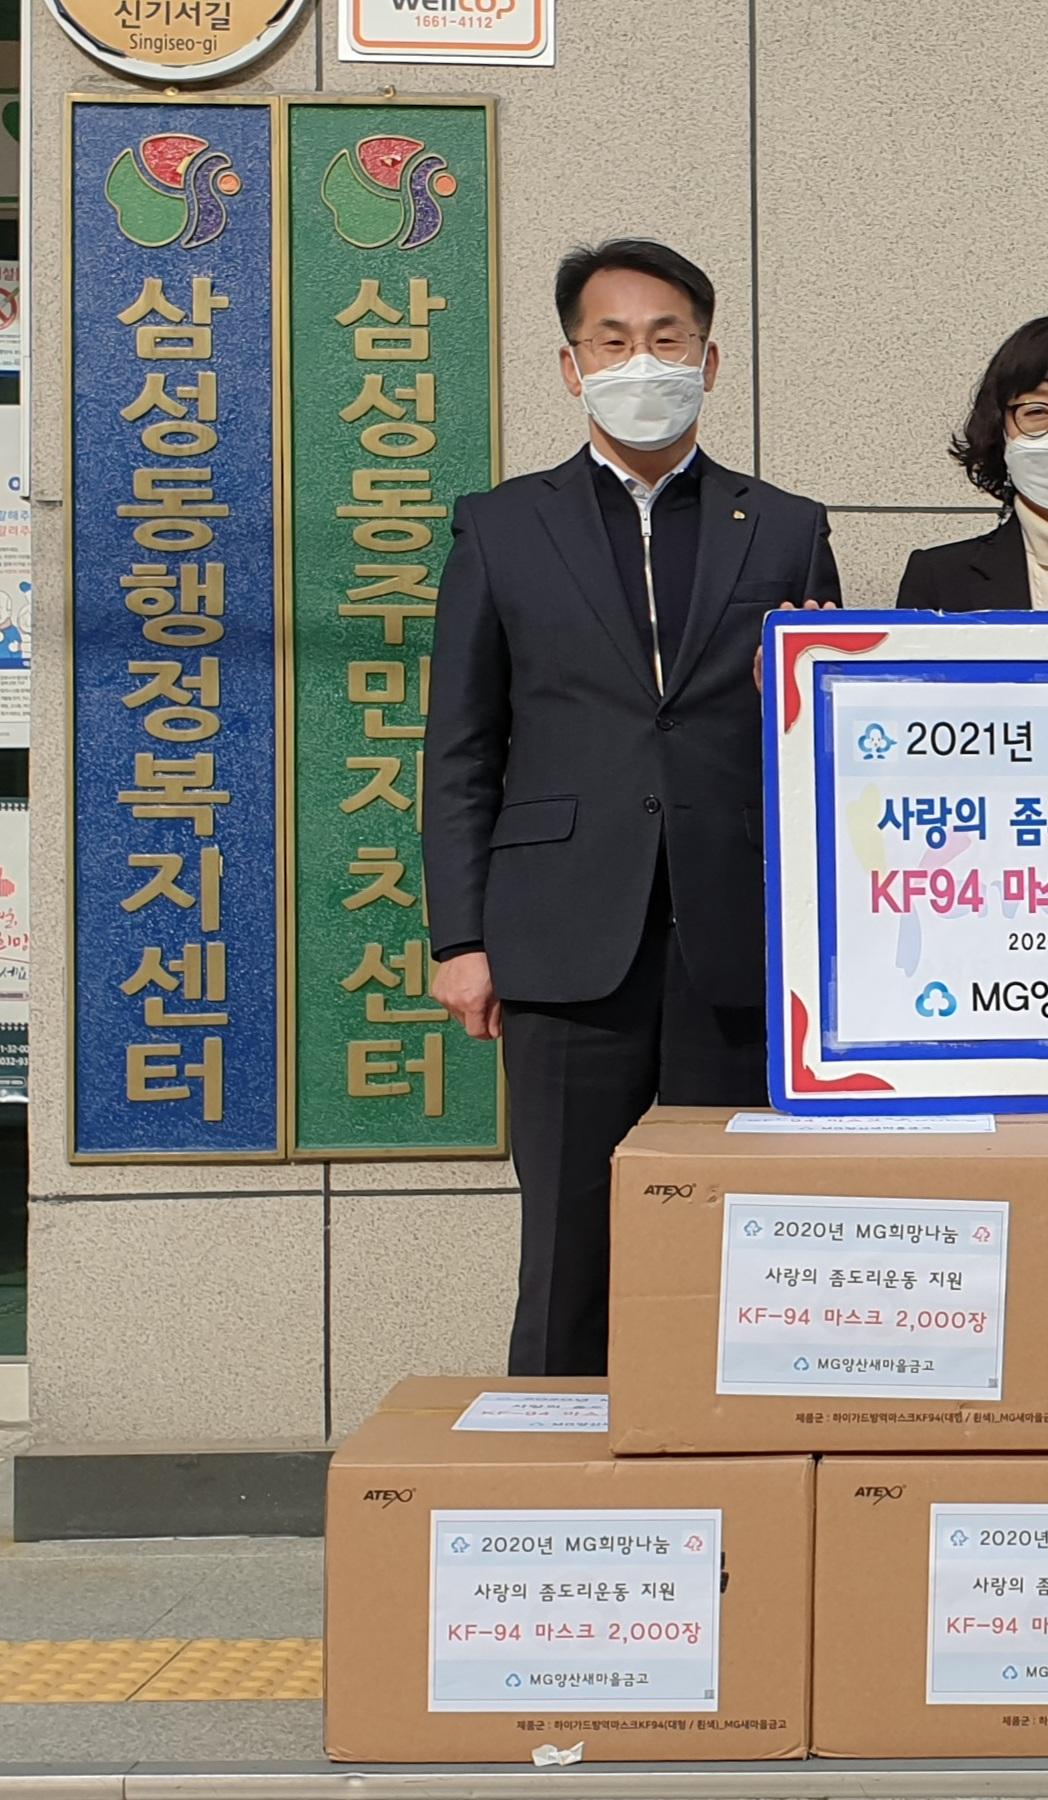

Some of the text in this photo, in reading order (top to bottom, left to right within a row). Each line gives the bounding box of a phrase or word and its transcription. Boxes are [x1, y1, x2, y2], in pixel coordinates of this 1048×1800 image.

[114, 0, 230, 31] 신기서길
[415, 15, 492, 28] 1661-4112
[130, 33, 216, 55] Singiseo-gi
[116, 277, 230, 1121] 삼성동행정복지센터
[907, 721, 1032, 762] 2021년
[878, 797, 986, 849] 사랑의
[872, 869, 983, 913] KF94
[774, 1222, 958, 1244] 2020년 MG희망나눔
[766, 1268, 961, 1290] 사랑의 좀도리운동 지원
[739, 1307, 987, 1333] KF-94 마스크 2,000장
[818, 1358, 934, 1373] MG양산새마을금고
[482, 1536, 670, 1555] 2020년 MG희망나눔
[980, 1530, 1048, 1549] 2020년
[474, 1582, 674, 1603] 사랑의 좀도리운동 지원
[973, 1577, 1023, 1596] 사랑의
[449, 1622, 701, 1644] KF-94 마스크 2,000장
[947, 1617, 1018, 1634] KF-94
[530, 1672, 648, 1688] MG양산새마을금고
